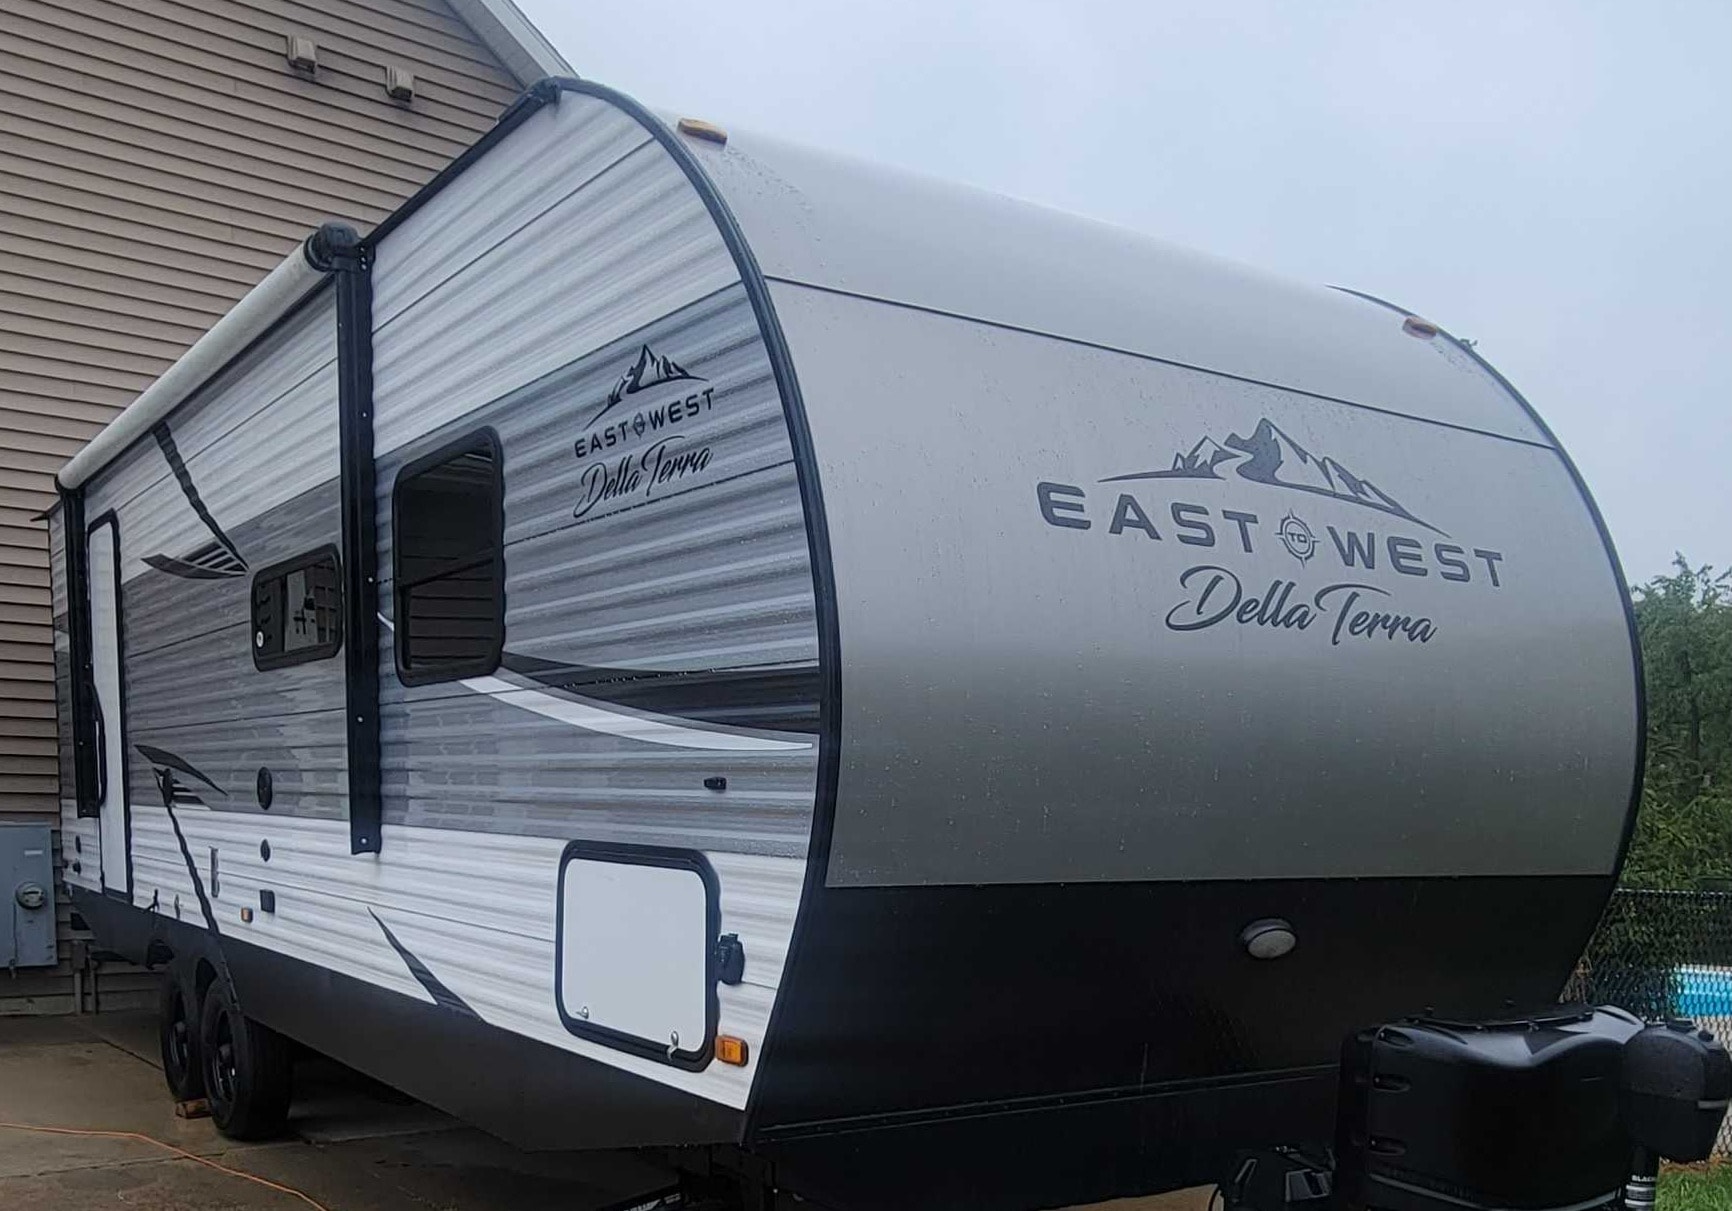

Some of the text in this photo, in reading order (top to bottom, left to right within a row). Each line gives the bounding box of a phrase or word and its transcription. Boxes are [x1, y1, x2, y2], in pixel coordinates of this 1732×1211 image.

[574, 387, 715, 458] EAST WEST
[573, 435, 714, 518] Della Terra
[1036, 481, 1259, 554] EAST
[1326, 525, 1504, 588] WEST
[1165, 565, 1438, 646] Della Terra
